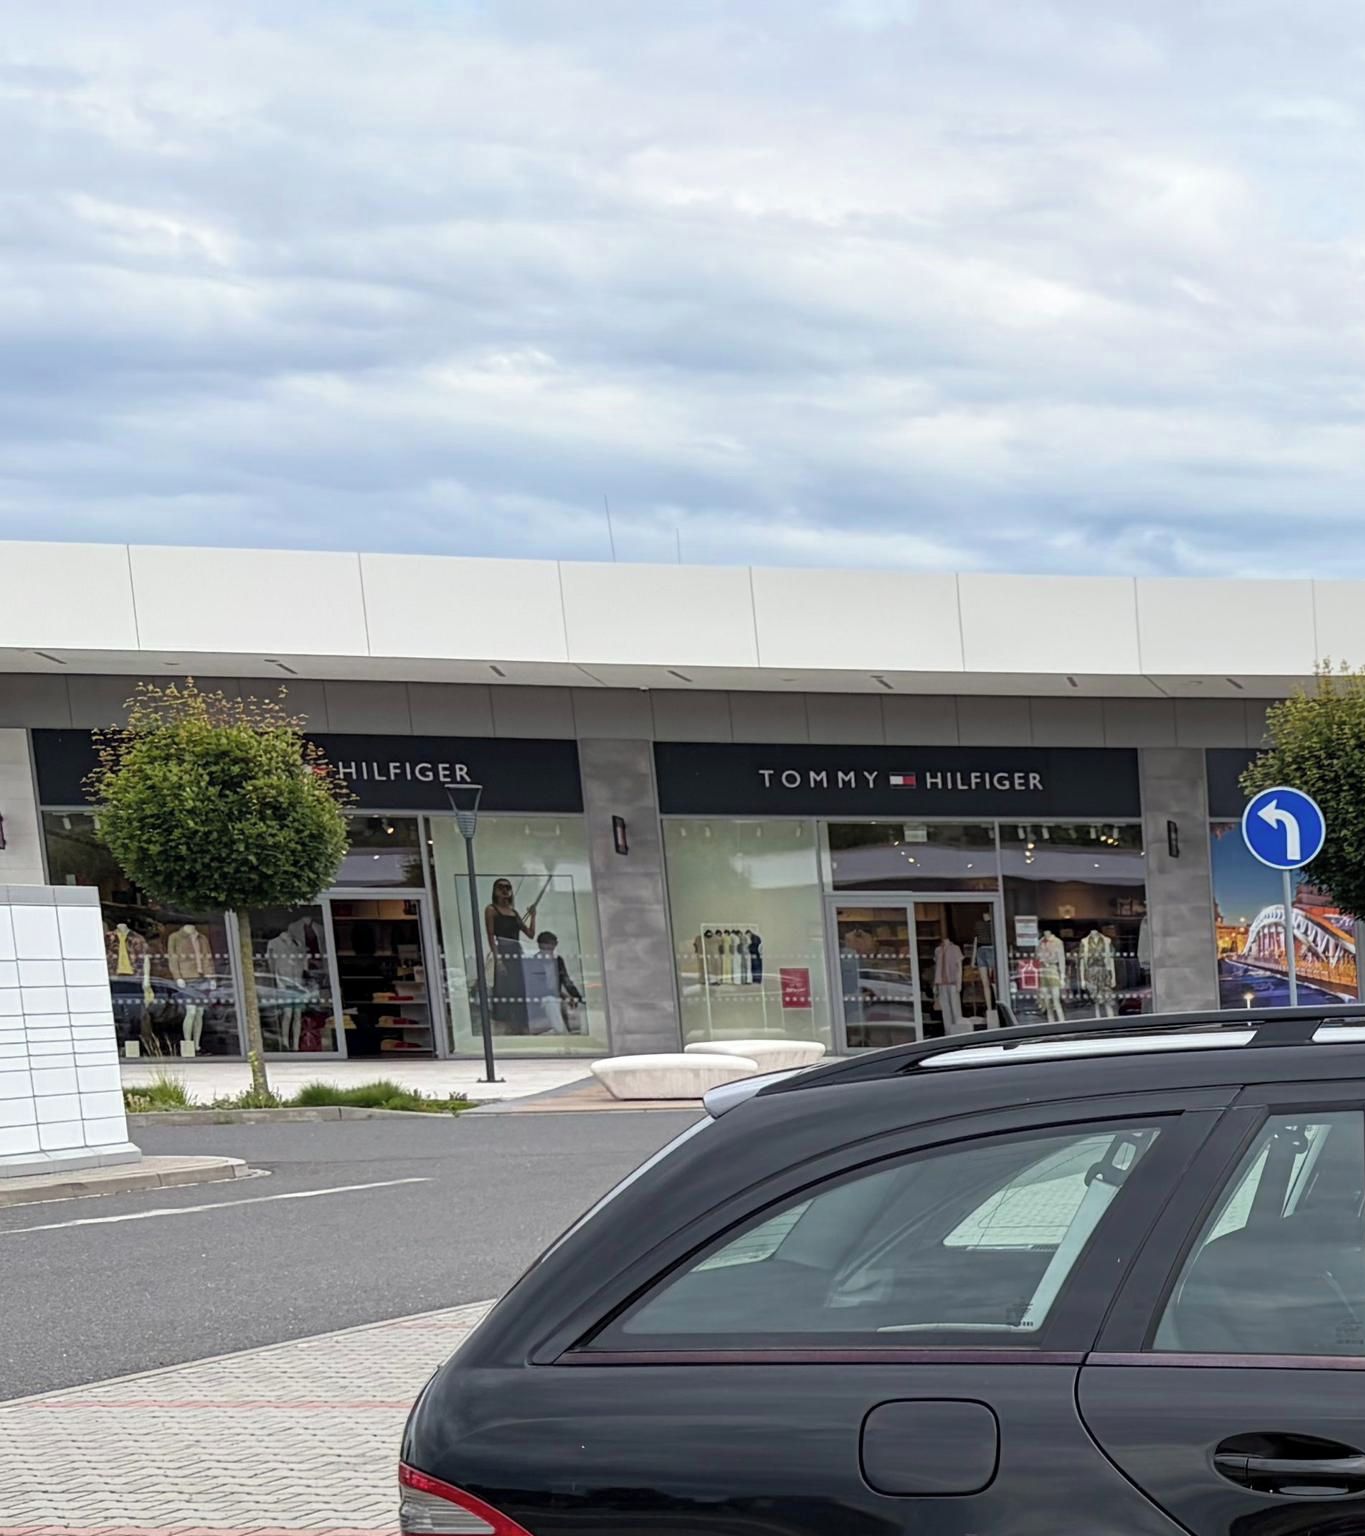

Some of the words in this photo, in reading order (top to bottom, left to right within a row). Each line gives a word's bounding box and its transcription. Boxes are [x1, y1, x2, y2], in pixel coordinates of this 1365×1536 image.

[338, 761, 472, 783] HILFIGER
[758, 769, 878, 789] TOMMY
[925, 771, 1044, 791] HILFIGER
